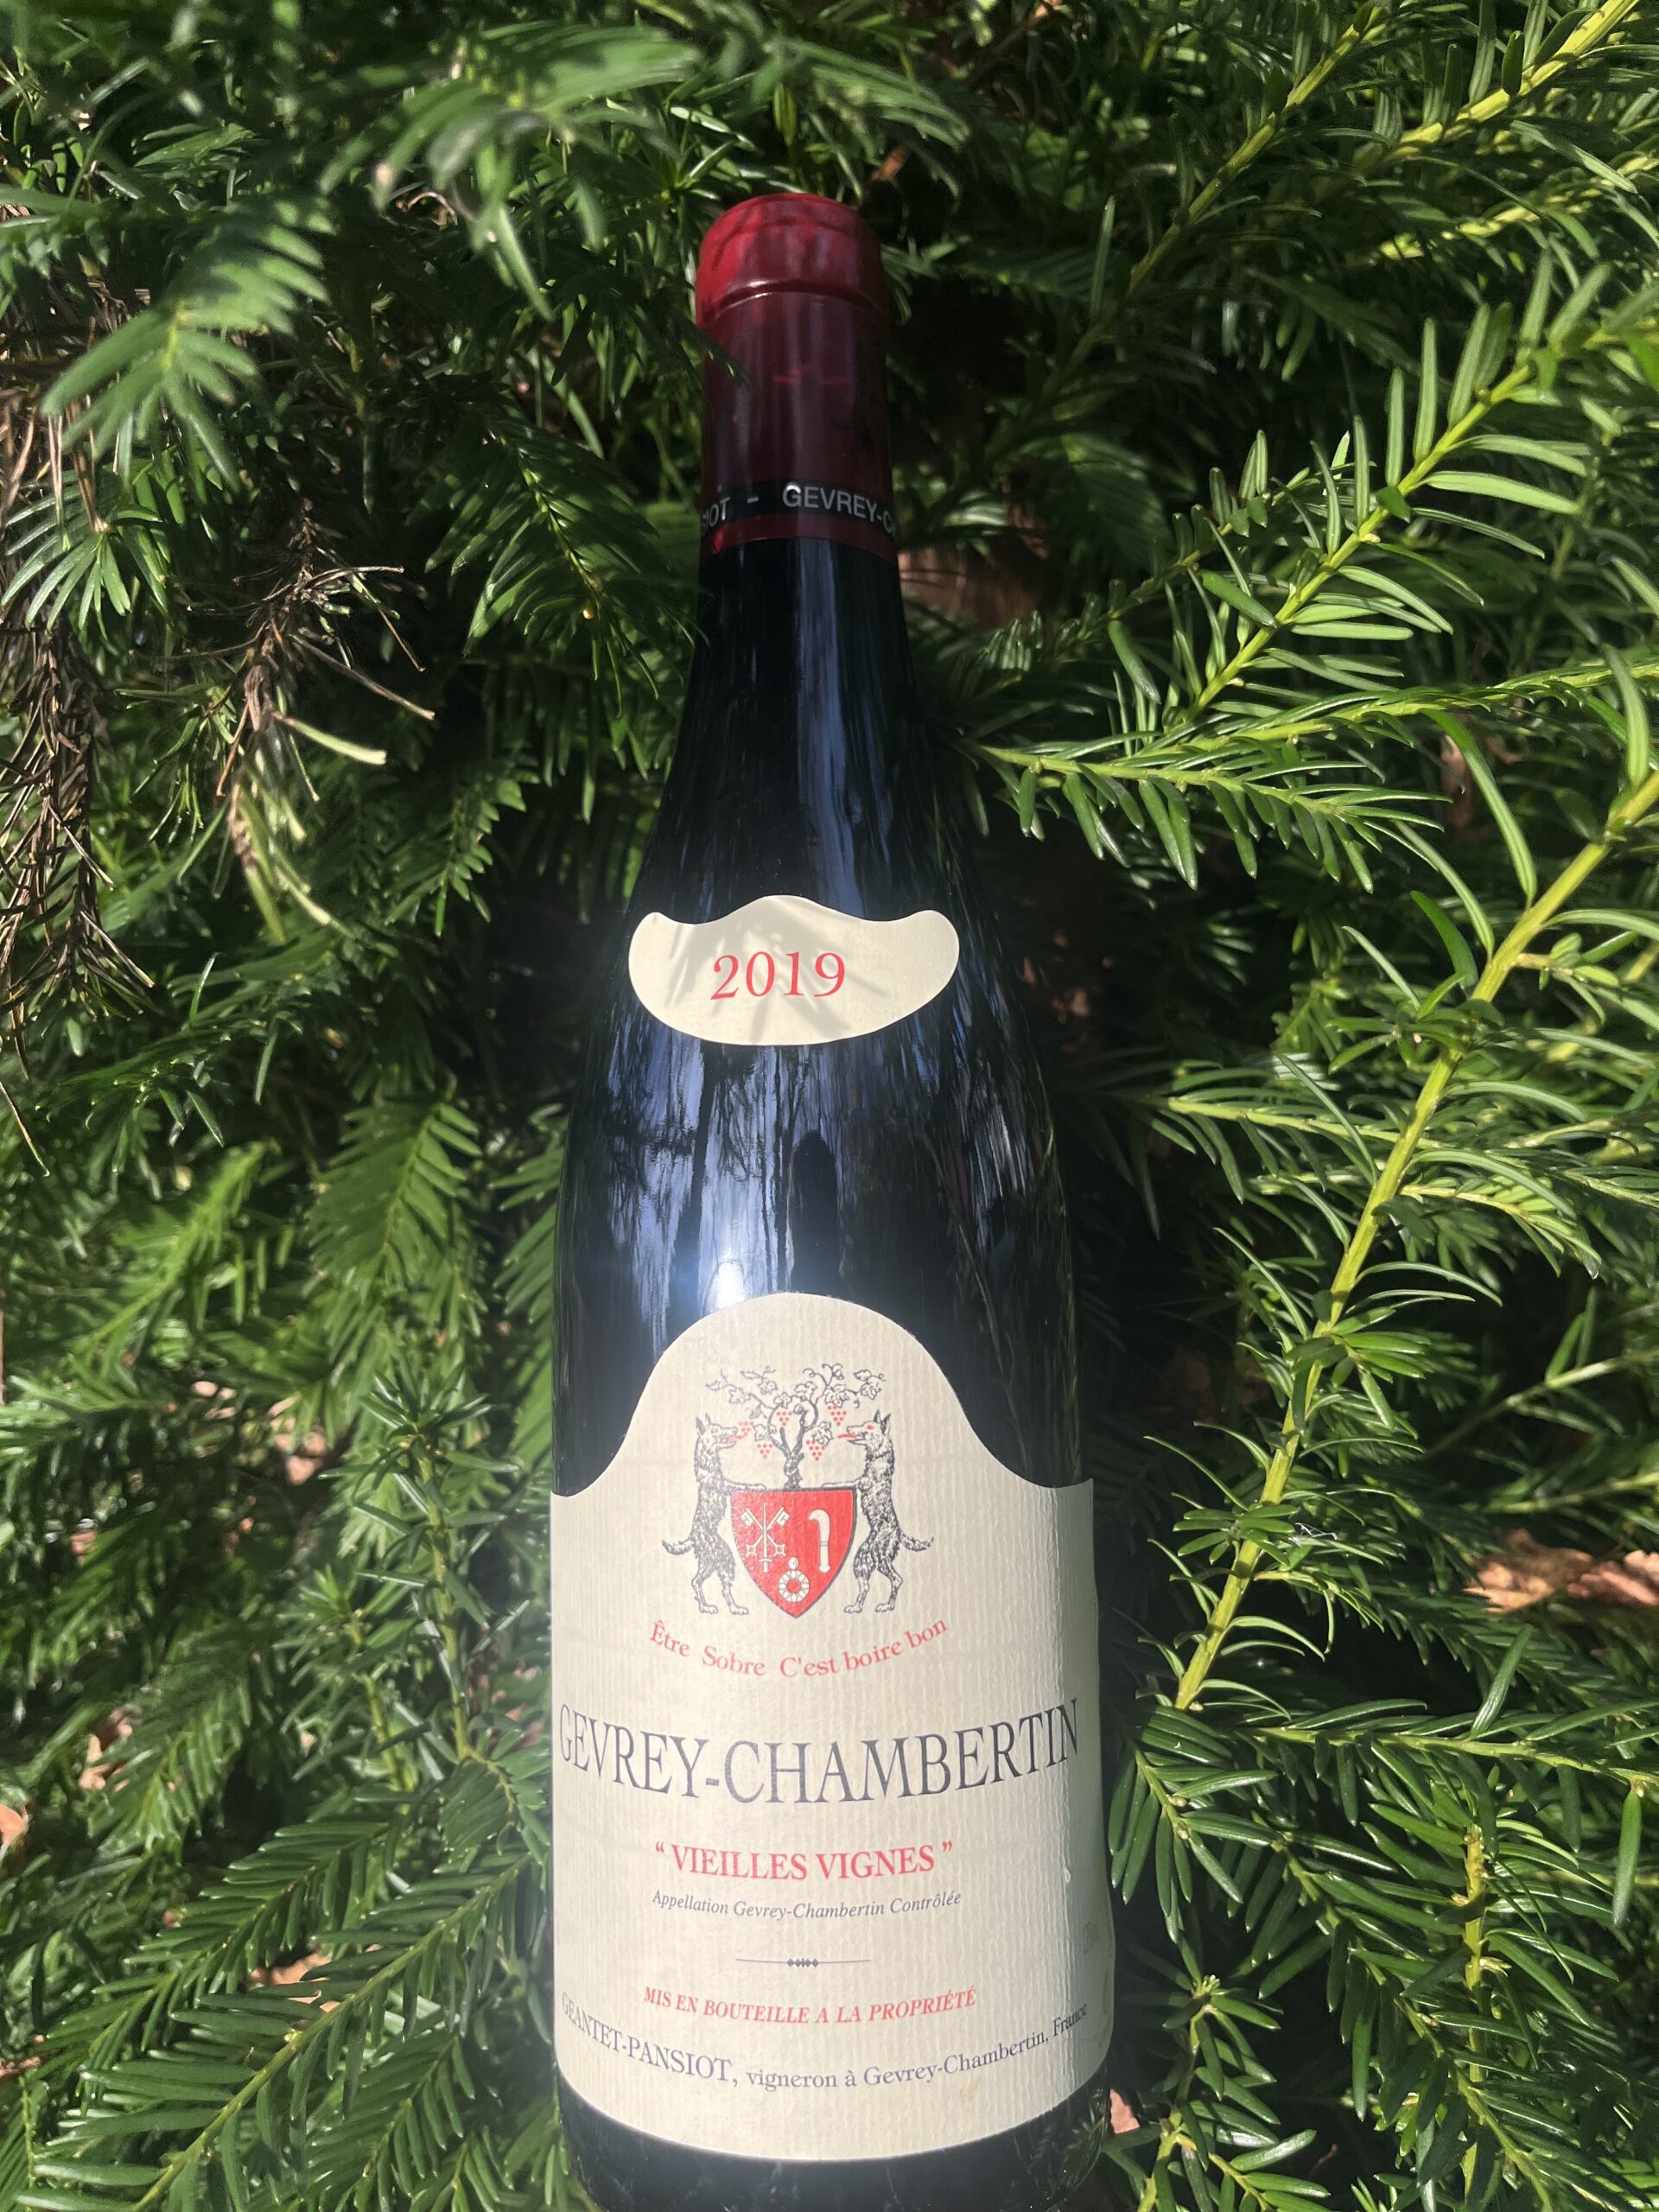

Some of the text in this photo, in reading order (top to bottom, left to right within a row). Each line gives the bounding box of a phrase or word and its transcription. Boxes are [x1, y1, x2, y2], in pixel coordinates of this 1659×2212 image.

[781, 482, 895, 534] GEVREY-C
[711, 951, 846, 1001] 2019
[650, 1618, 948, 1678] Être Sobre C'est boire bon
[560, 1697, 1078, 1804] GEVREY-CHAMBERTIN
[652, 1889, 963, 1922] Appellation Gevrey-Chambertin Contrôlée
[644, 1985, 978, 2024] MIS EN BOUTEILLE A LA PROPRIÉTÉ
[562, 1991, 1087, 2092] GEANTET-PANSIOT, vigneron à Gevrey-Chambertin, France
